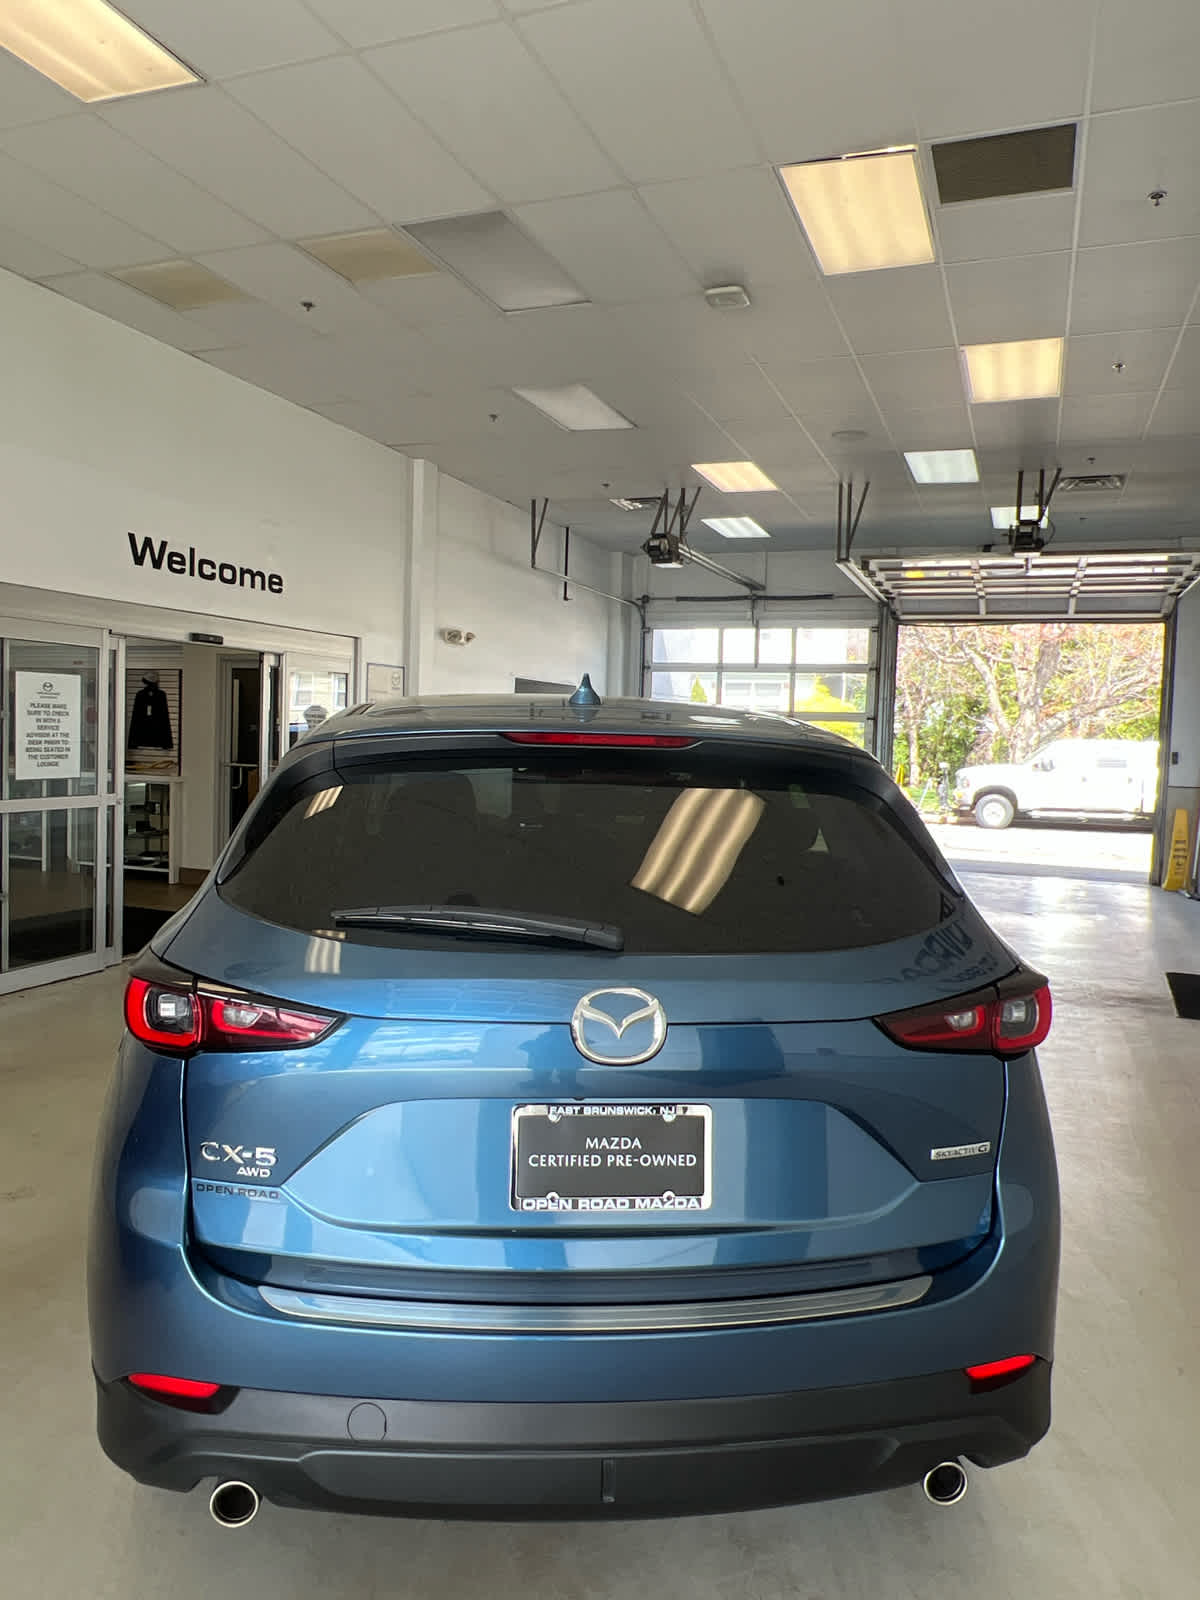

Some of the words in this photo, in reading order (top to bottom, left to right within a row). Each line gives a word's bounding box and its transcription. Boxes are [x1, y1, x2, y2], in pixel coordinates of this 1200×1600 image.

[127, 532, 284, 594] Welcome
[585, 1137, 642, 1150] MAZDA
[200, 1141, 278, 1167] CX-5
[528, 1154, 602, 1167] CERTIFIED
[606, 1154, 697, 1167] PRE-OWNED
[236, 1166, 271, 1178] AWD
[196, 1183, 234, 1196] OPEN
[238, 1188, 280, 1200] ROAD
[522, 1199, 573, 1210] OPEN
[578, 1199, 630, 1210] ROAD
[635, 1198, 700, 1210] MAZDA
